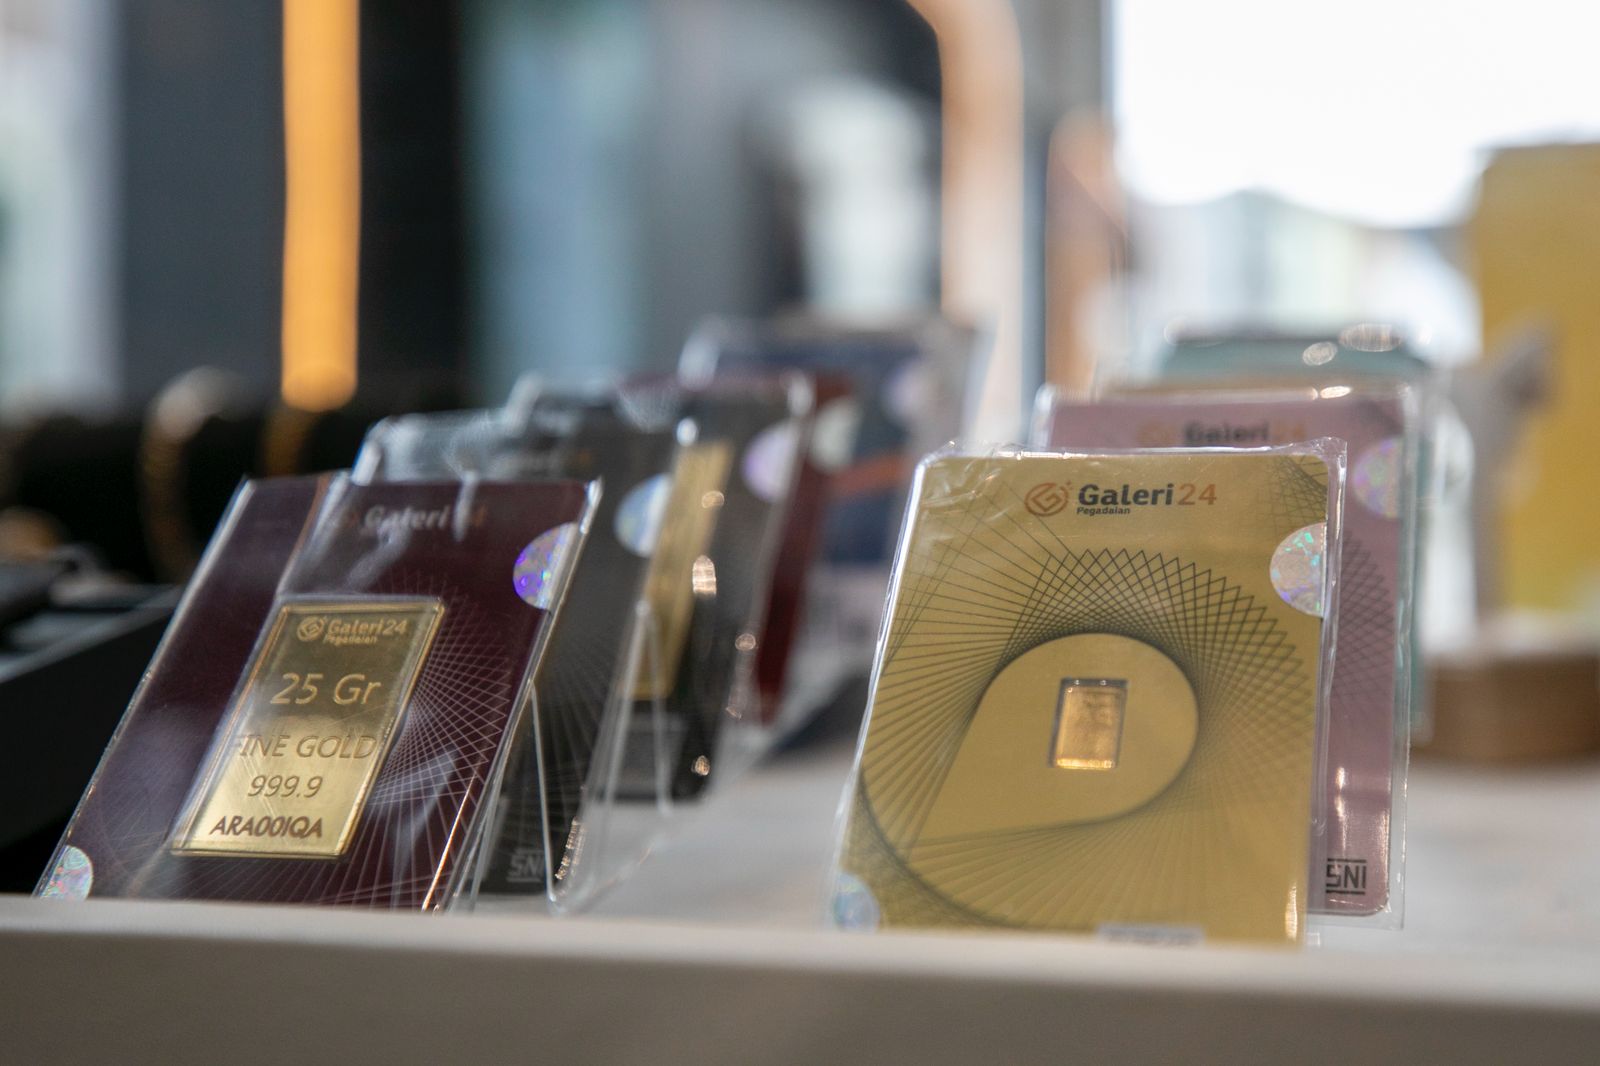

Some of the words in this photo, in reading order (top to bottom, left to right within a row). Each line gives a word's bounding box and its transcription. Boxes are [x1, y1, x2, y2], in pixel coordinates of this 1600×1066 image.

[1077, 483, 1217, 506] Galeri24
[1076, 506, 1131, 517] Pegadaian
[327, 617, 408, 636] Galeri24
[270, 673, 323, 704] 25
[333, 673, 382, 704] Gr
[296, 735, 376, 759] GOLD
[247, 775, 323, 798] 999.9
[1326, 864, 1367, 889] SNI
